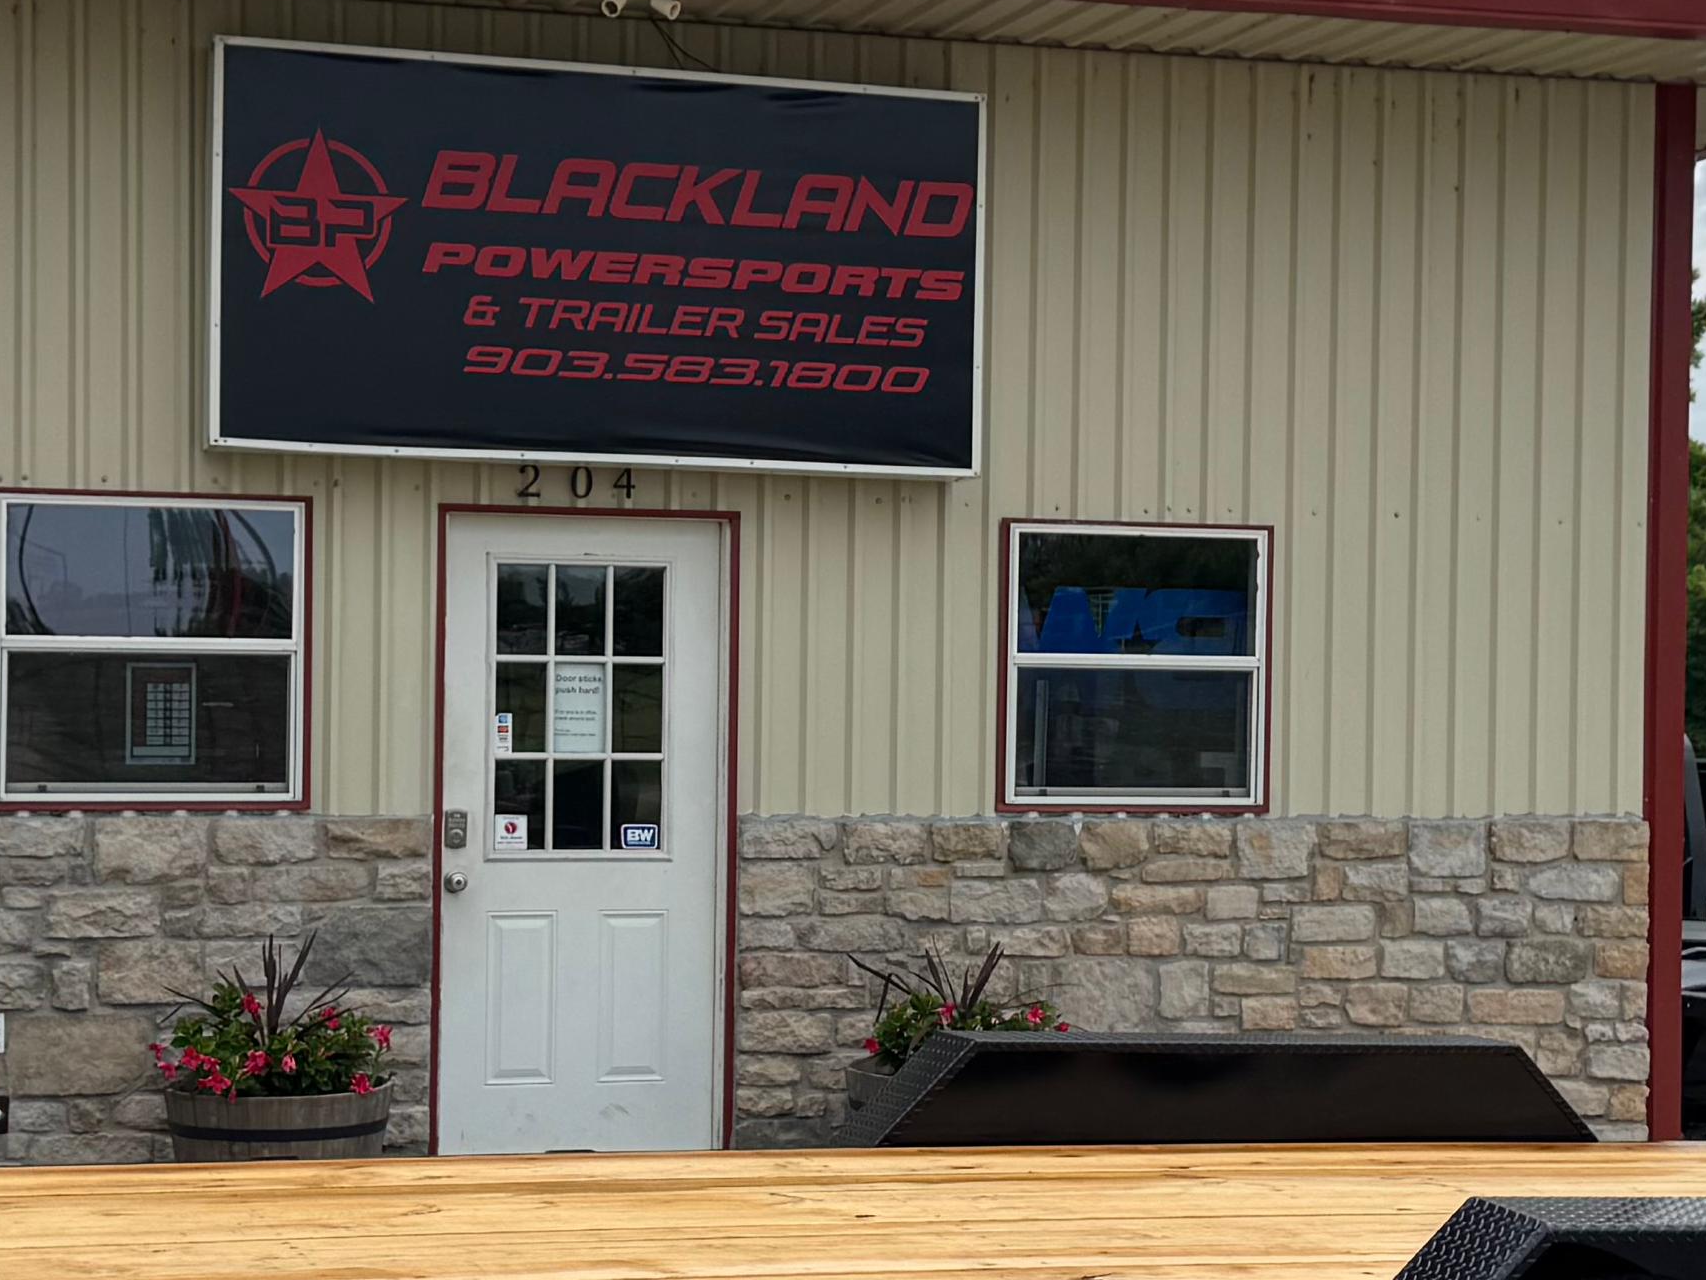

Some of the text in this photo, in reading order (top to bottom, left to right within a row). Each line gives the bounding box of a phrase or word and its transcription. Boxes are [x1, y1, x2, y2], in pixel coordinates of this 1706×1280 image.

[422, 150, 974, 237] BLACKLAND
[422, 242, 965, 301] POWERSPORTS
[463, 296, 928, 348] & TRAILER SALES
[463, 346, 930, 393] 903.583.1800
[555, 673, 577, 682] Door
